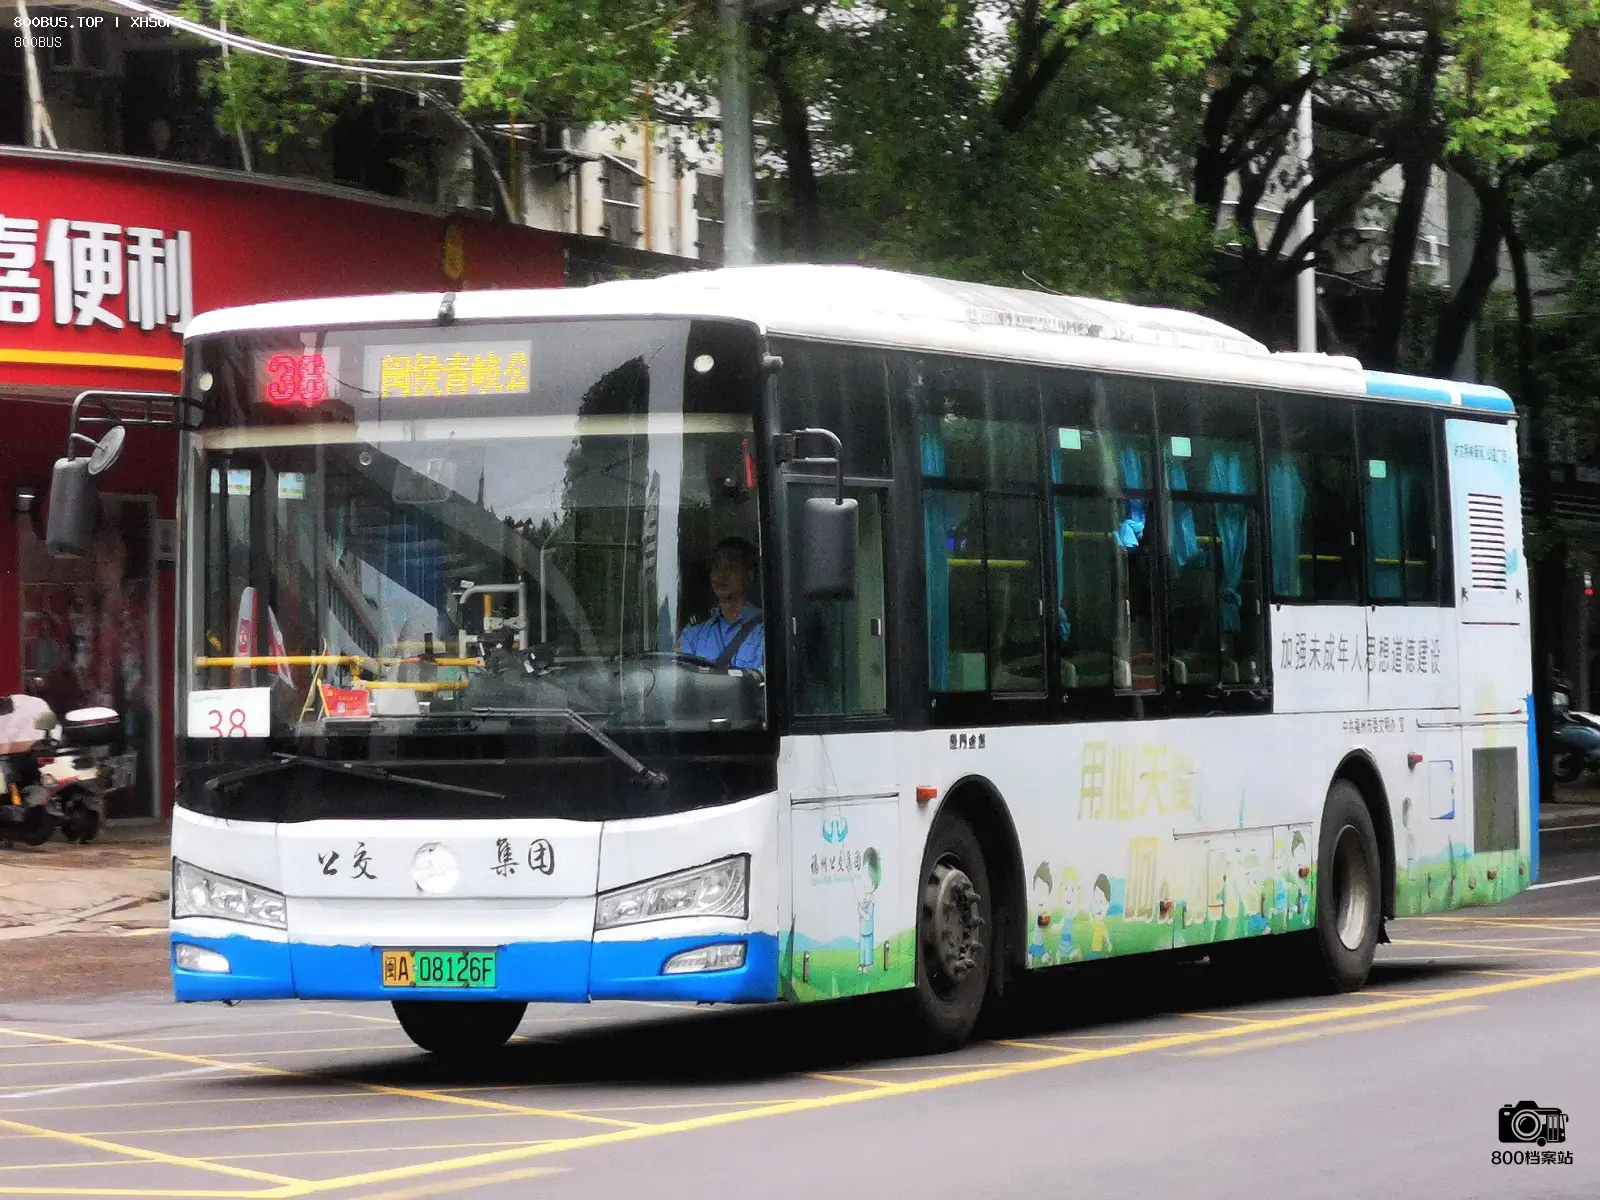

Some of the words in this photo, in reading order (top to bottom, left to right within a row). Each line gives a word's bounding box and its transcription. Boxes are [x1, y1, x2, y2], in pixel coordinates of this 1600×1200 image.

[264, 351, 329, 405] 38
[318, 842, 378, 880] 公交
[490, 838, 555, 877] 集团
